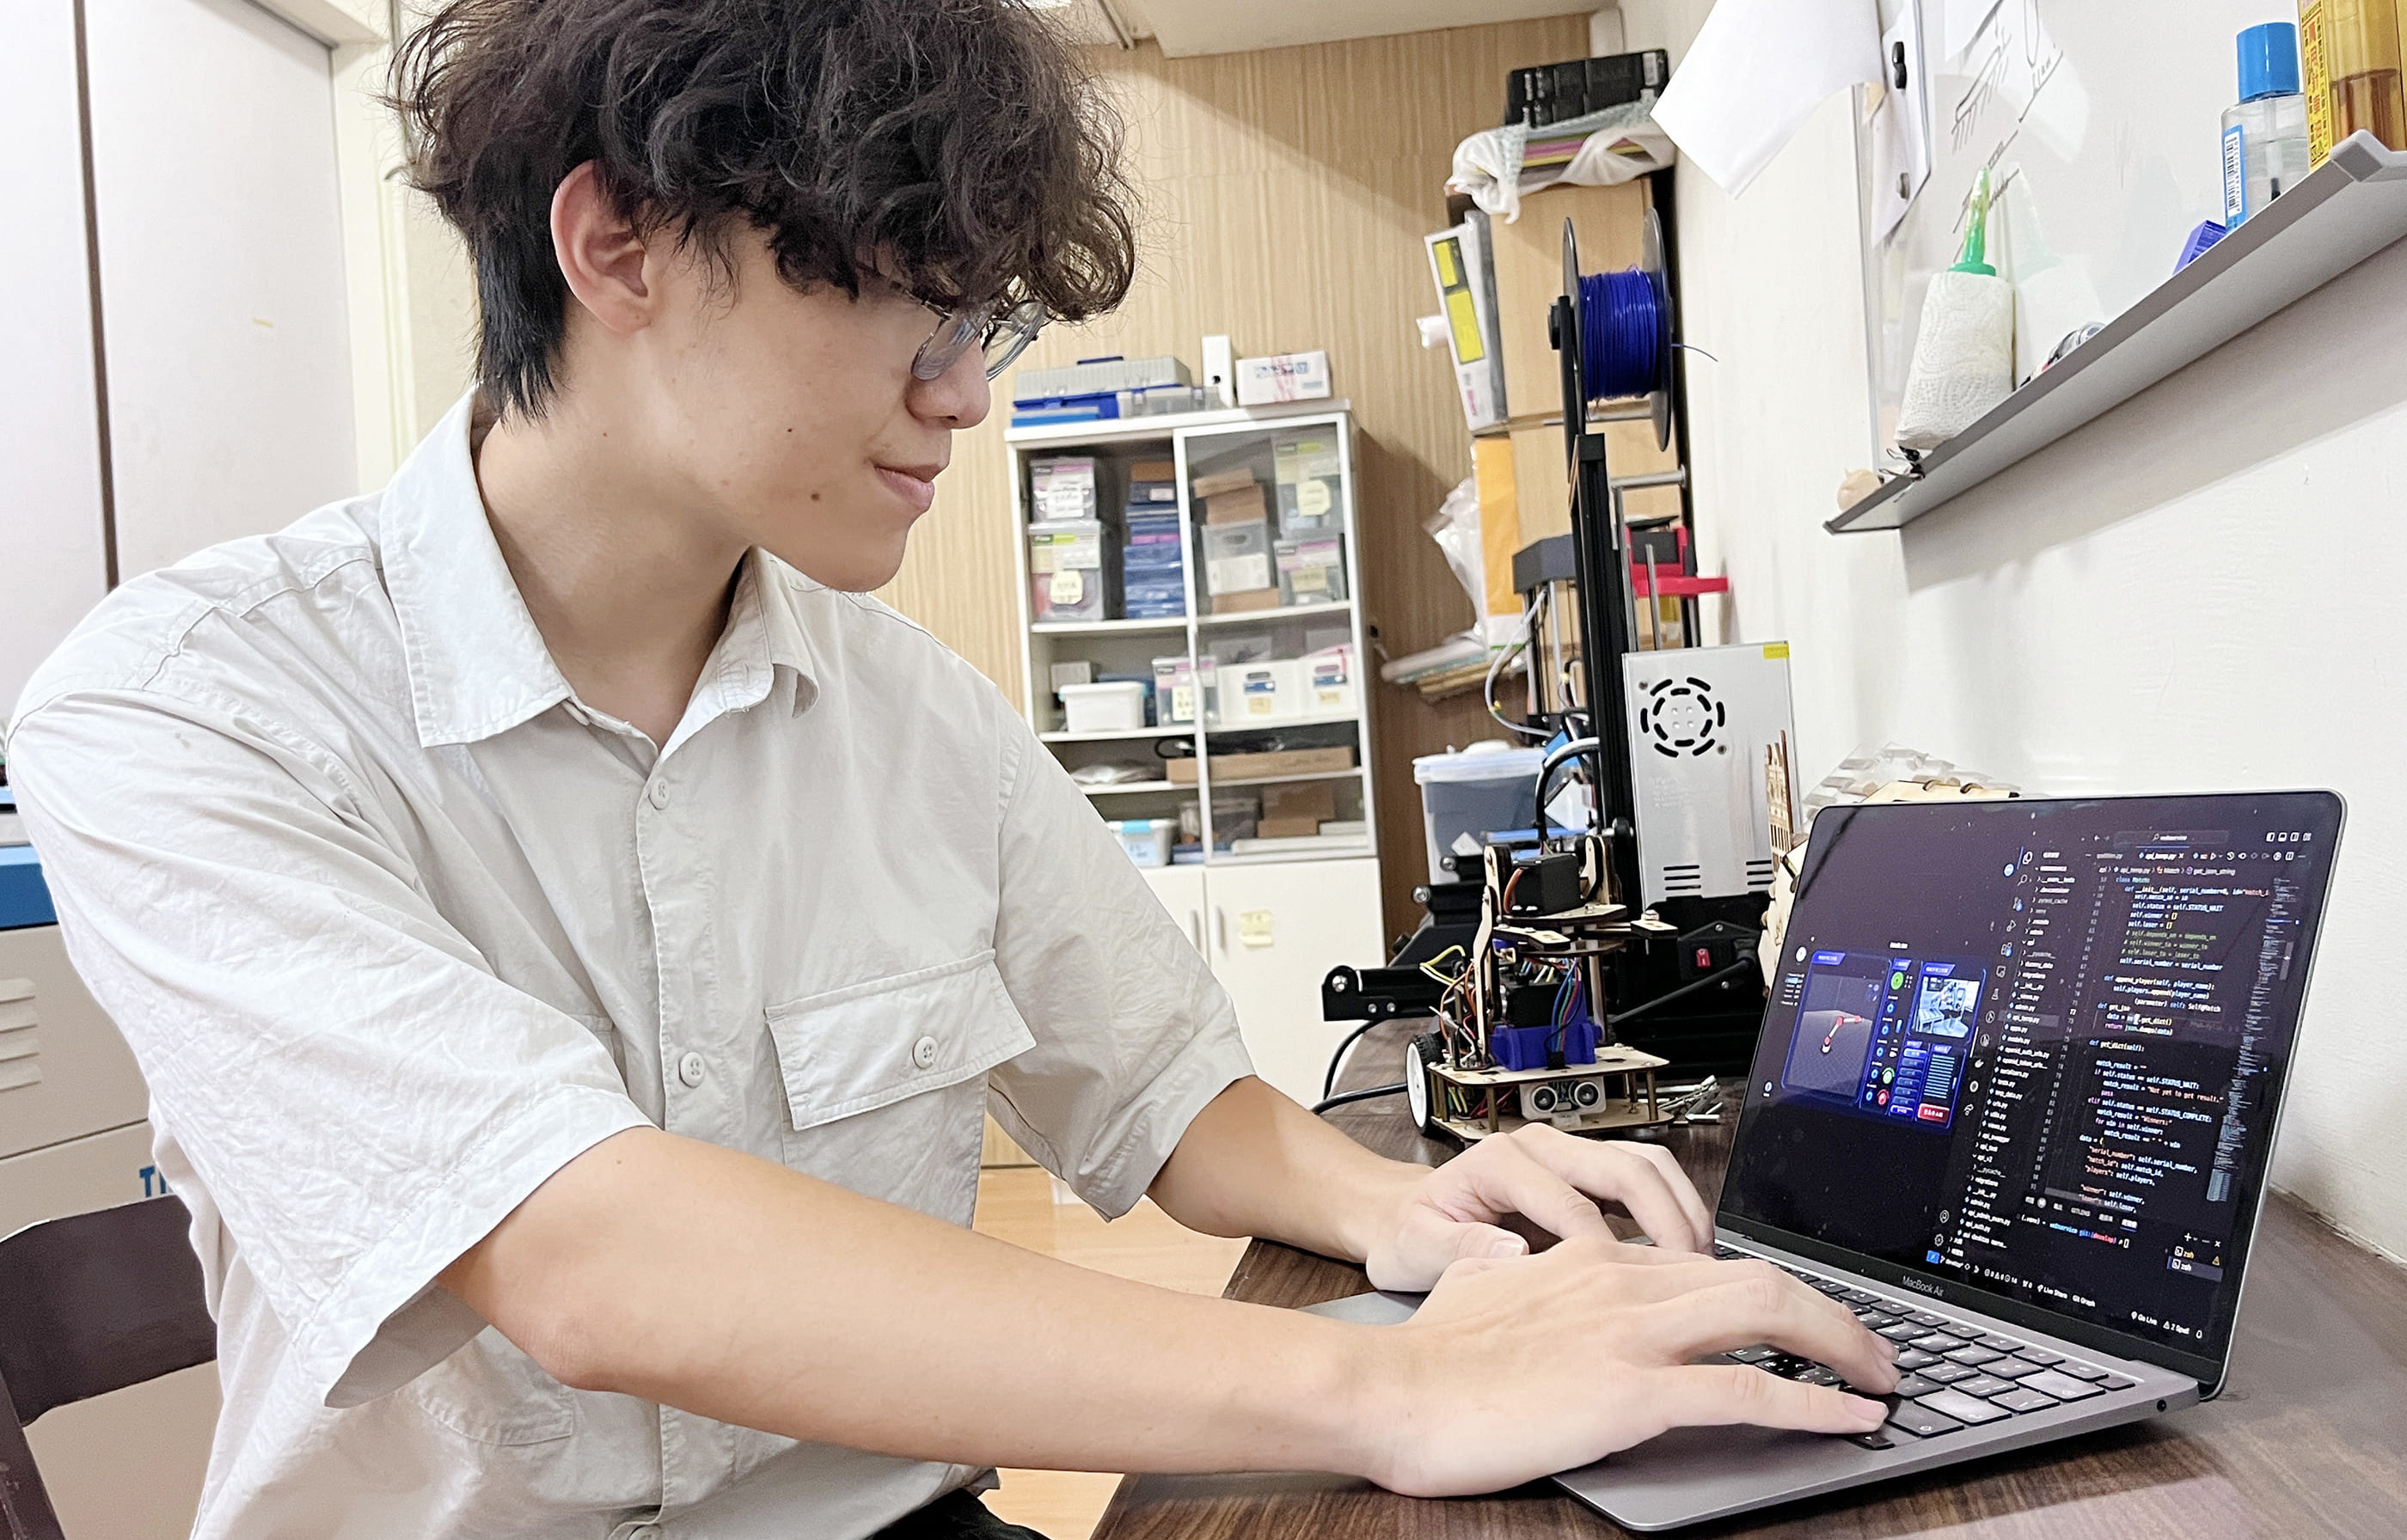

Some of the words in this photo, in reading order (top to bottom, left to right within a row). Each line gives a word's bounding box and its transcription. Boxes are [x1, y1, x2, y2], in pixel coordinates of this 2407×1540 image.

[2119, 957, 2173, 967] self.serial_number
[2181, 962, 2222, 970] serial_number
[1902, 1274, 1934, 1294] MacBook
[1934, 1284, 1945, 1298] Air
